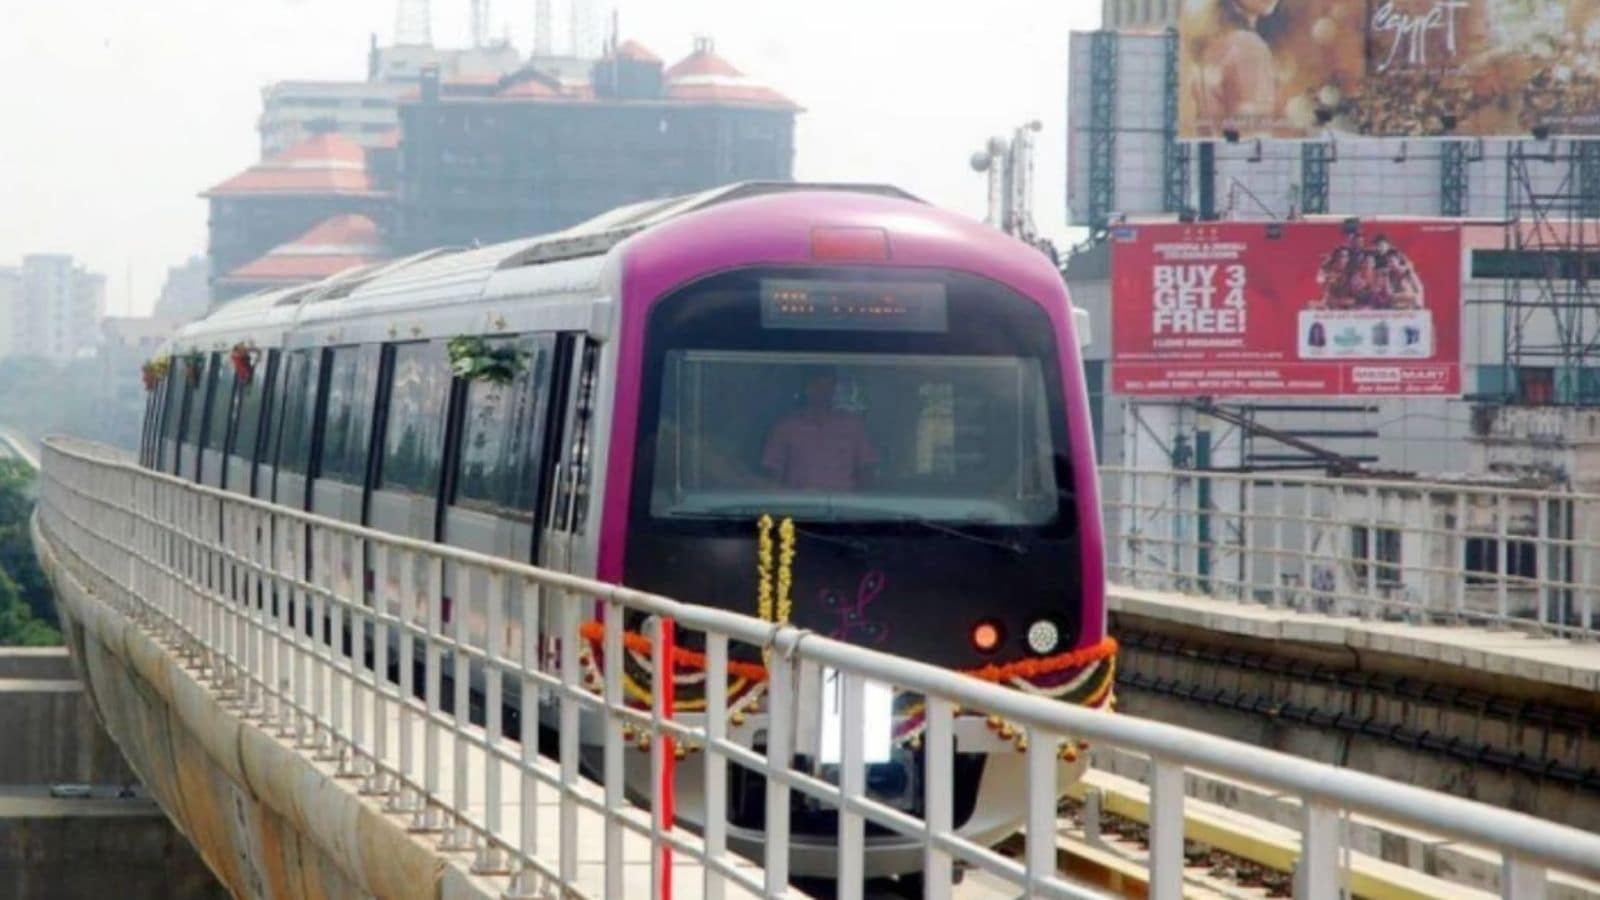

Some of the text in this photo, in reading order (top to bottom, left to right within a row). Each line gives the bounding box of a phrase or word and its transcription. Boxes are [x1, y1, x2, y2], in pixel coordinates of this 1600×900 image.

[1153, 264, 1247, 288] BUY 3
[1153, 287, 1247, 310] GET 4
[1152, 309, 1246, 334] FREE!
